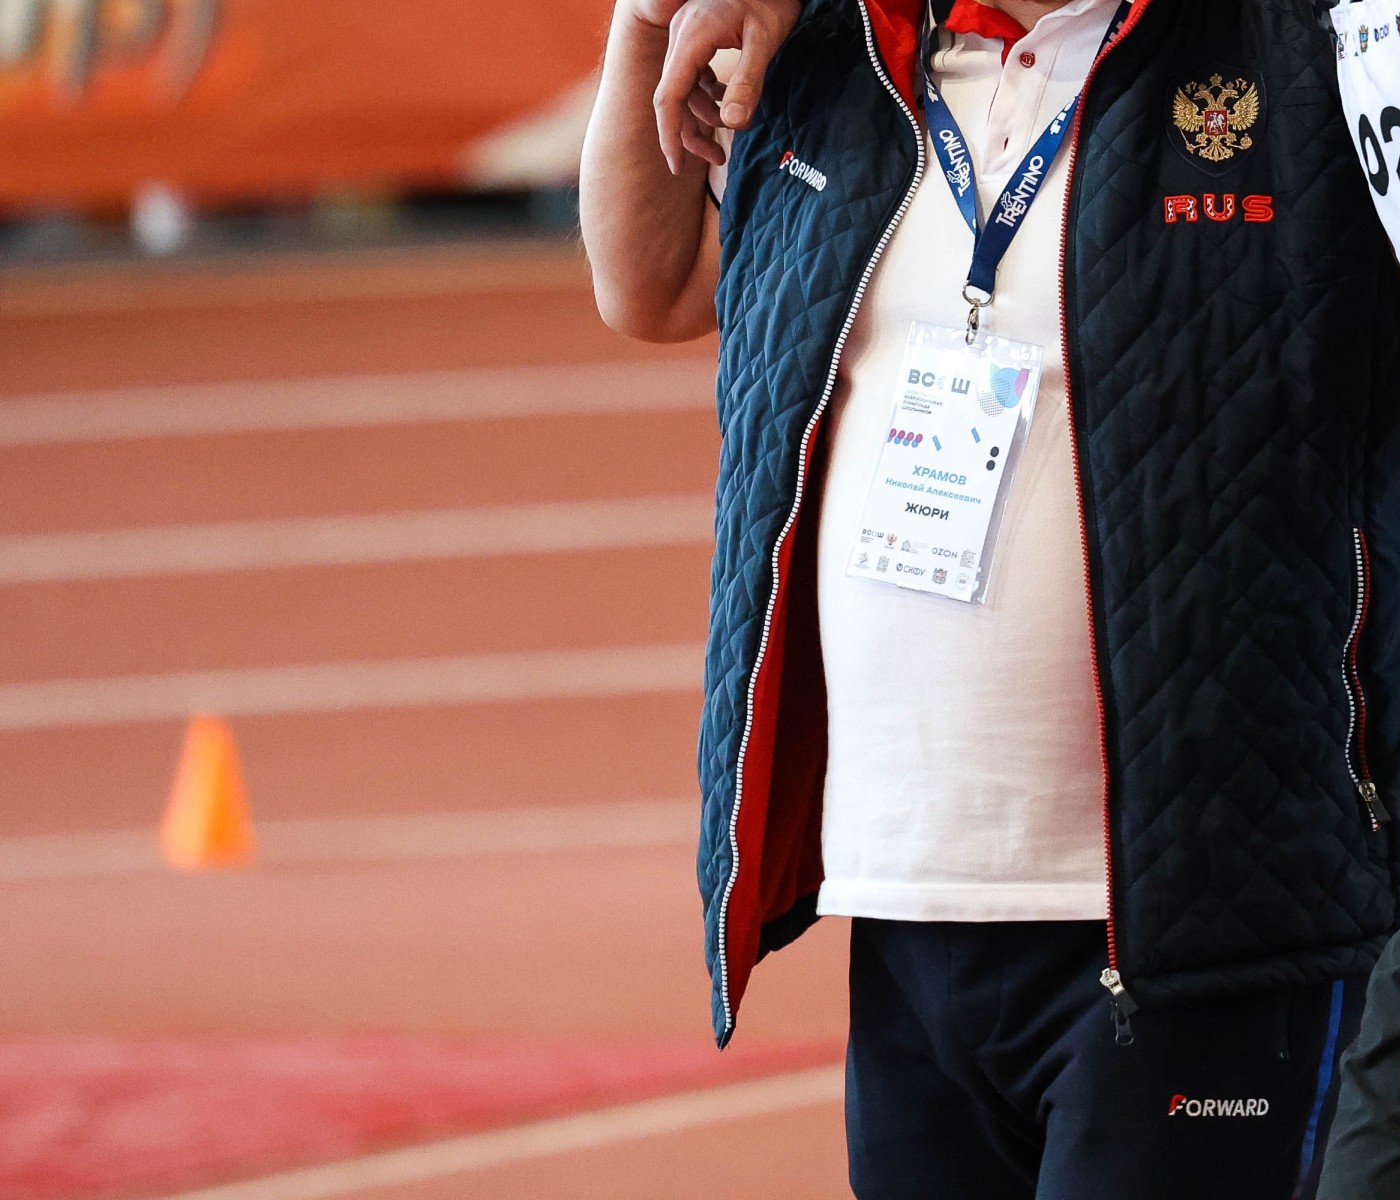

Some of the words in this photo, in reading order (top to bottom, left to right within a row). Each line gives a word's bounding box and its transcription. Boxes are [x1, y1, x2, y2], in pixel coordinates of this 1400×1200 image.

[779, 151, 827, 192] FORWARD
[939, 128, 972, 198] TRENTINO
[995, 154, 1044, 228] TRENTINO
[1164, 193, 1274, 223] RUS
[912, 465, 968, 486] ХРАМОВ
[885, 477, 925, 493] Николай
[926, 486, 982, 505] Алексеевич
[904, 502, 950, 521] ЖЮРИ
[931, 547, 958, 559] OZON
[1168, 1093, 1270, 1117] FORWARD
